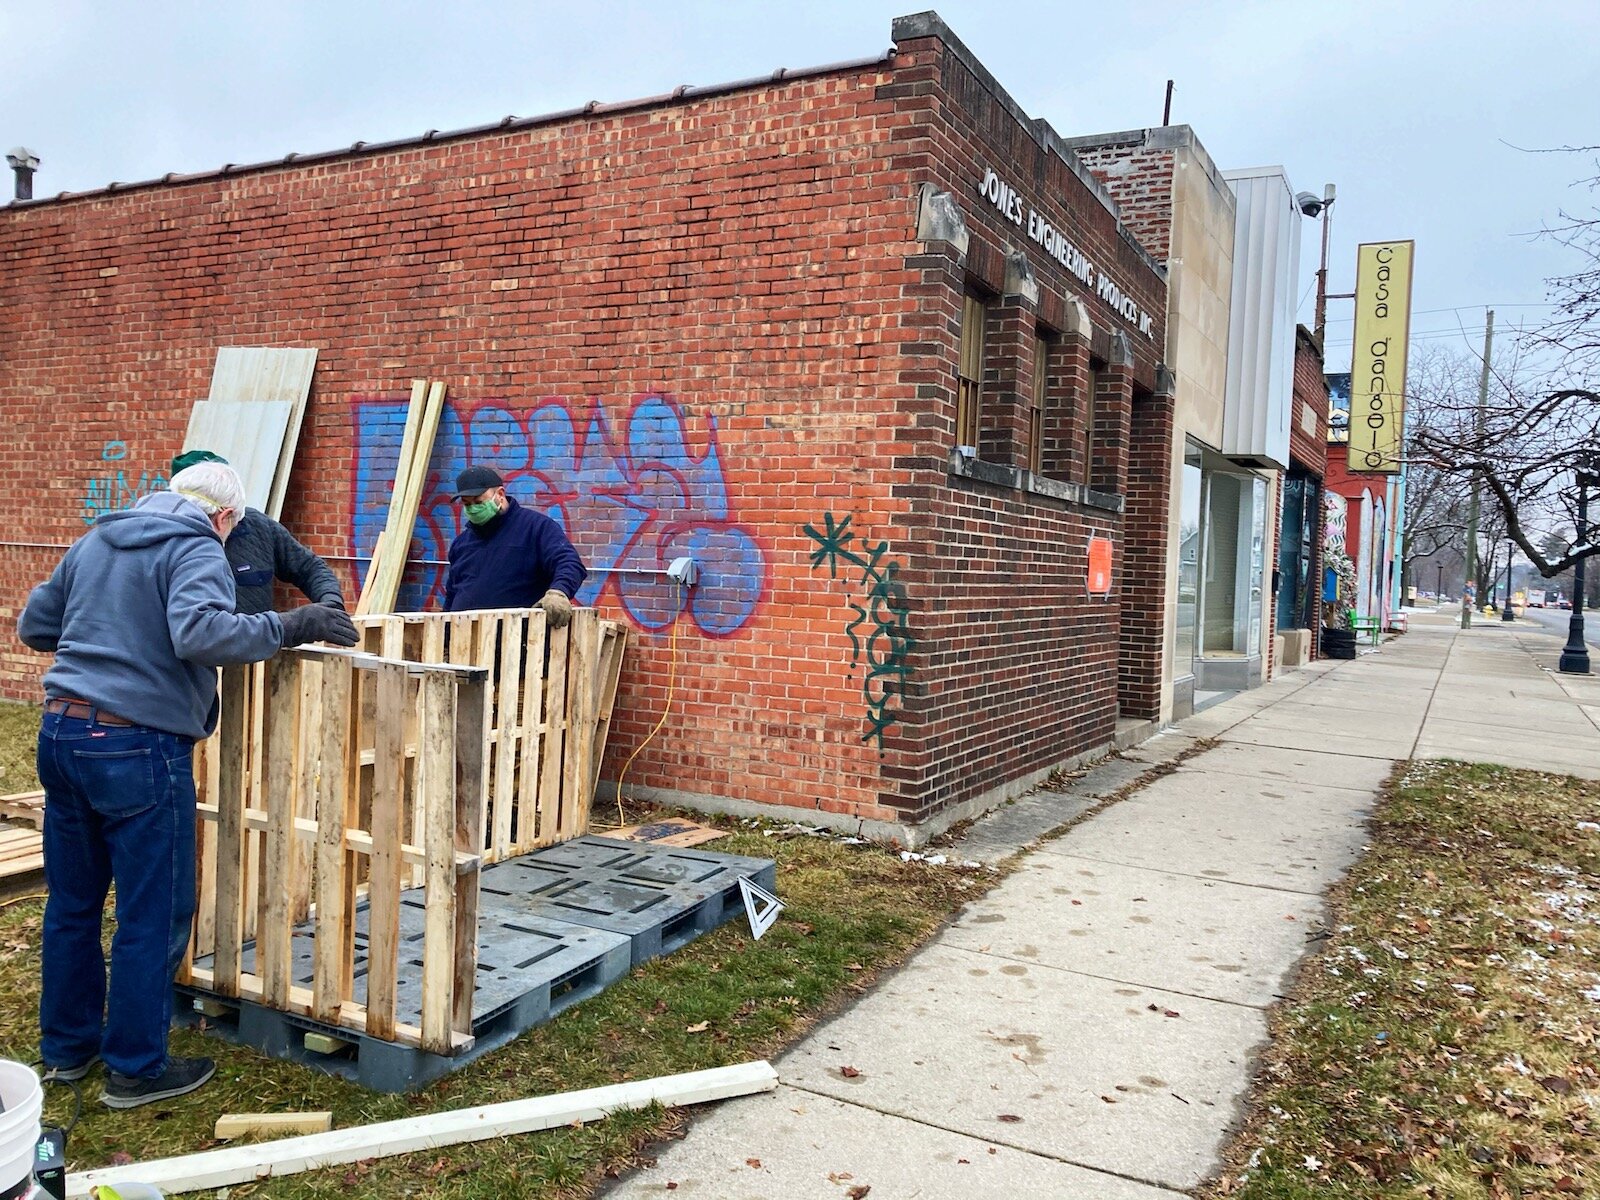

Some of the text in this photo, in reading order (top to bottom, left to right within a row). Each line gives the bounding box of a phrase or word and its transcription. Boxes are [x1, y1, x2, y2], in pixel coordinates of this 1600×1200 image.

[979, 167, 1023, 226] JONES
[1027, 209, 1094, 287] ENGINEERING
[1096, 272, 1138, 325] PRODUCTS
